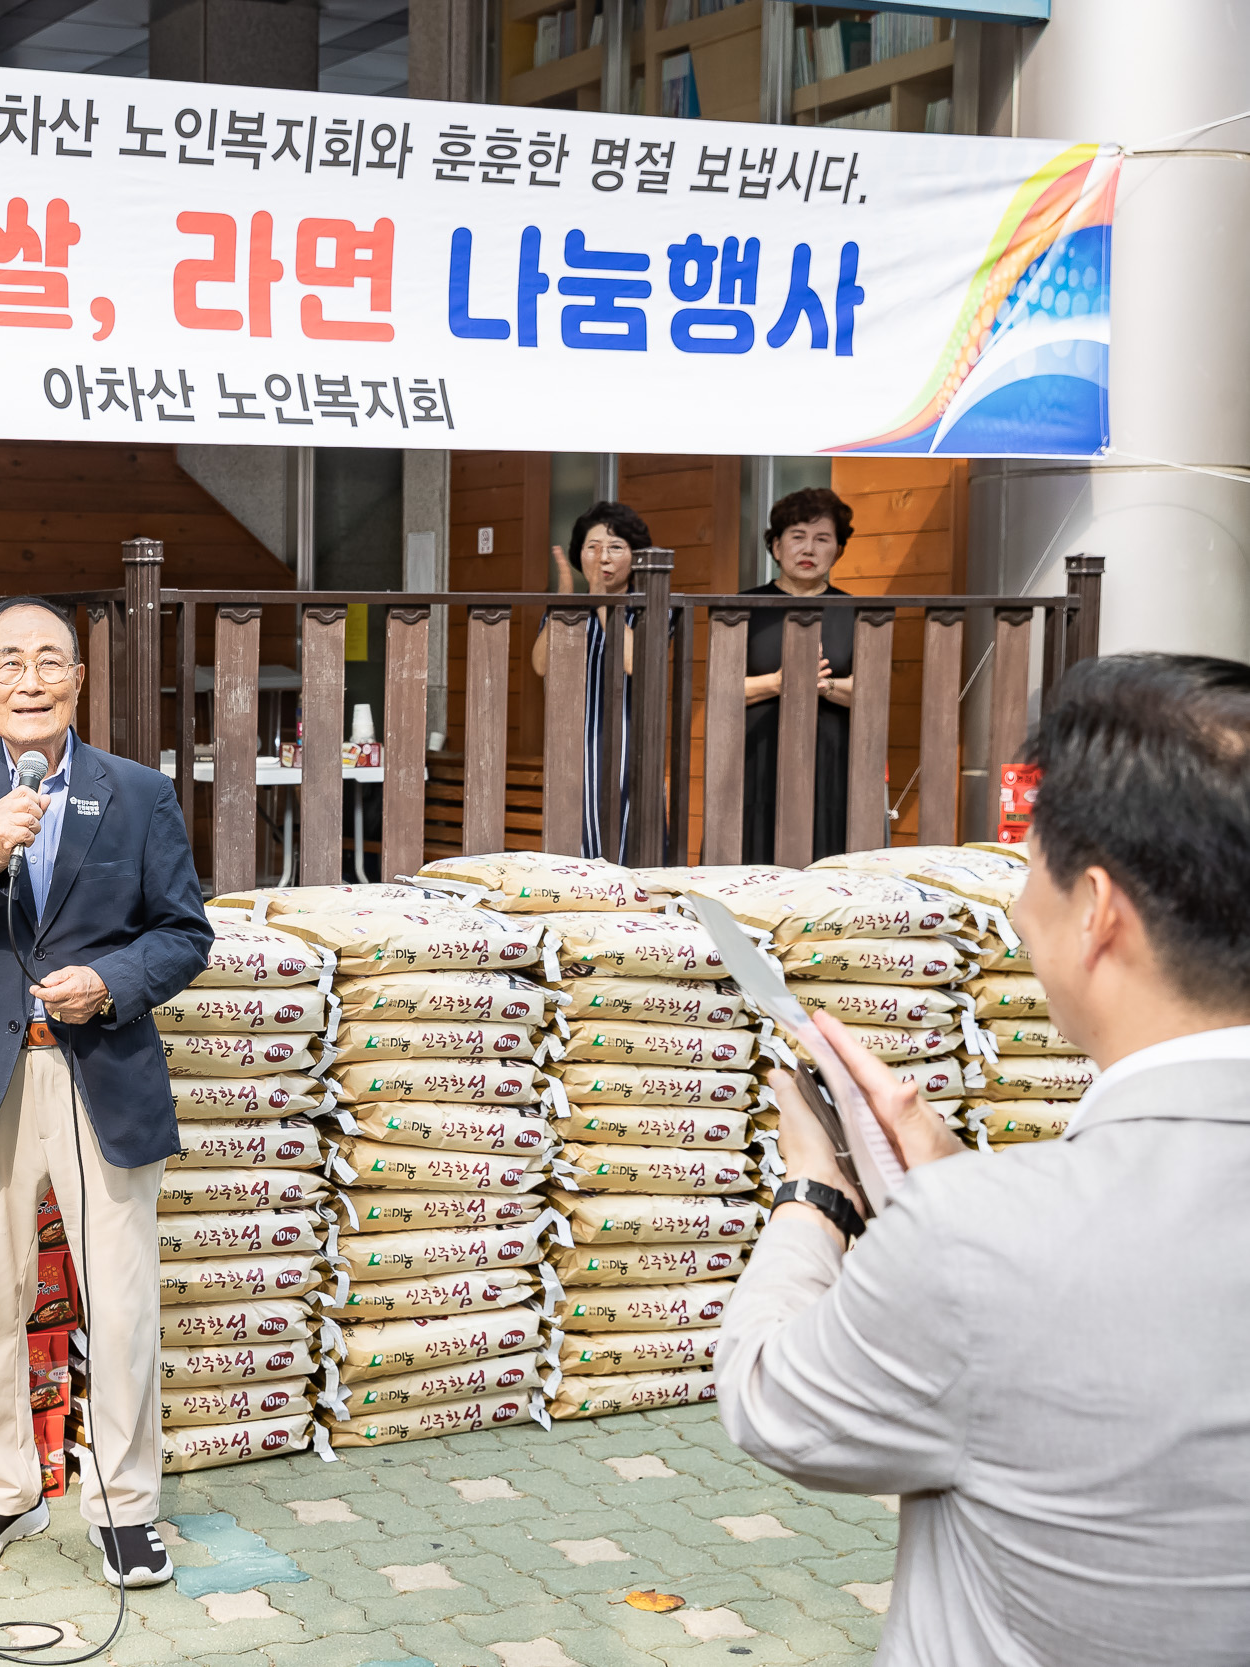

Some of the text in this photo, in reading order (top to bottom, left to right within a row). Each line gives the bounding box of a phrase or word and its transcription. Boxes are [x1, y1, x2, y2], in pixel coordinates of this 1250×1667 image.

[119, 105, 414, 180] 노인복지회와
[432, 124, 570, 190] 훈훈한
[591, 136, 675, 195] 명절
[690, 143, 868, 205] 보냅시다.
[173, 209, 396, 343] 라면
[448, 224, 865, 356] 나눔행사
[43, 363, 456, 430] 아차산 노인복지회
